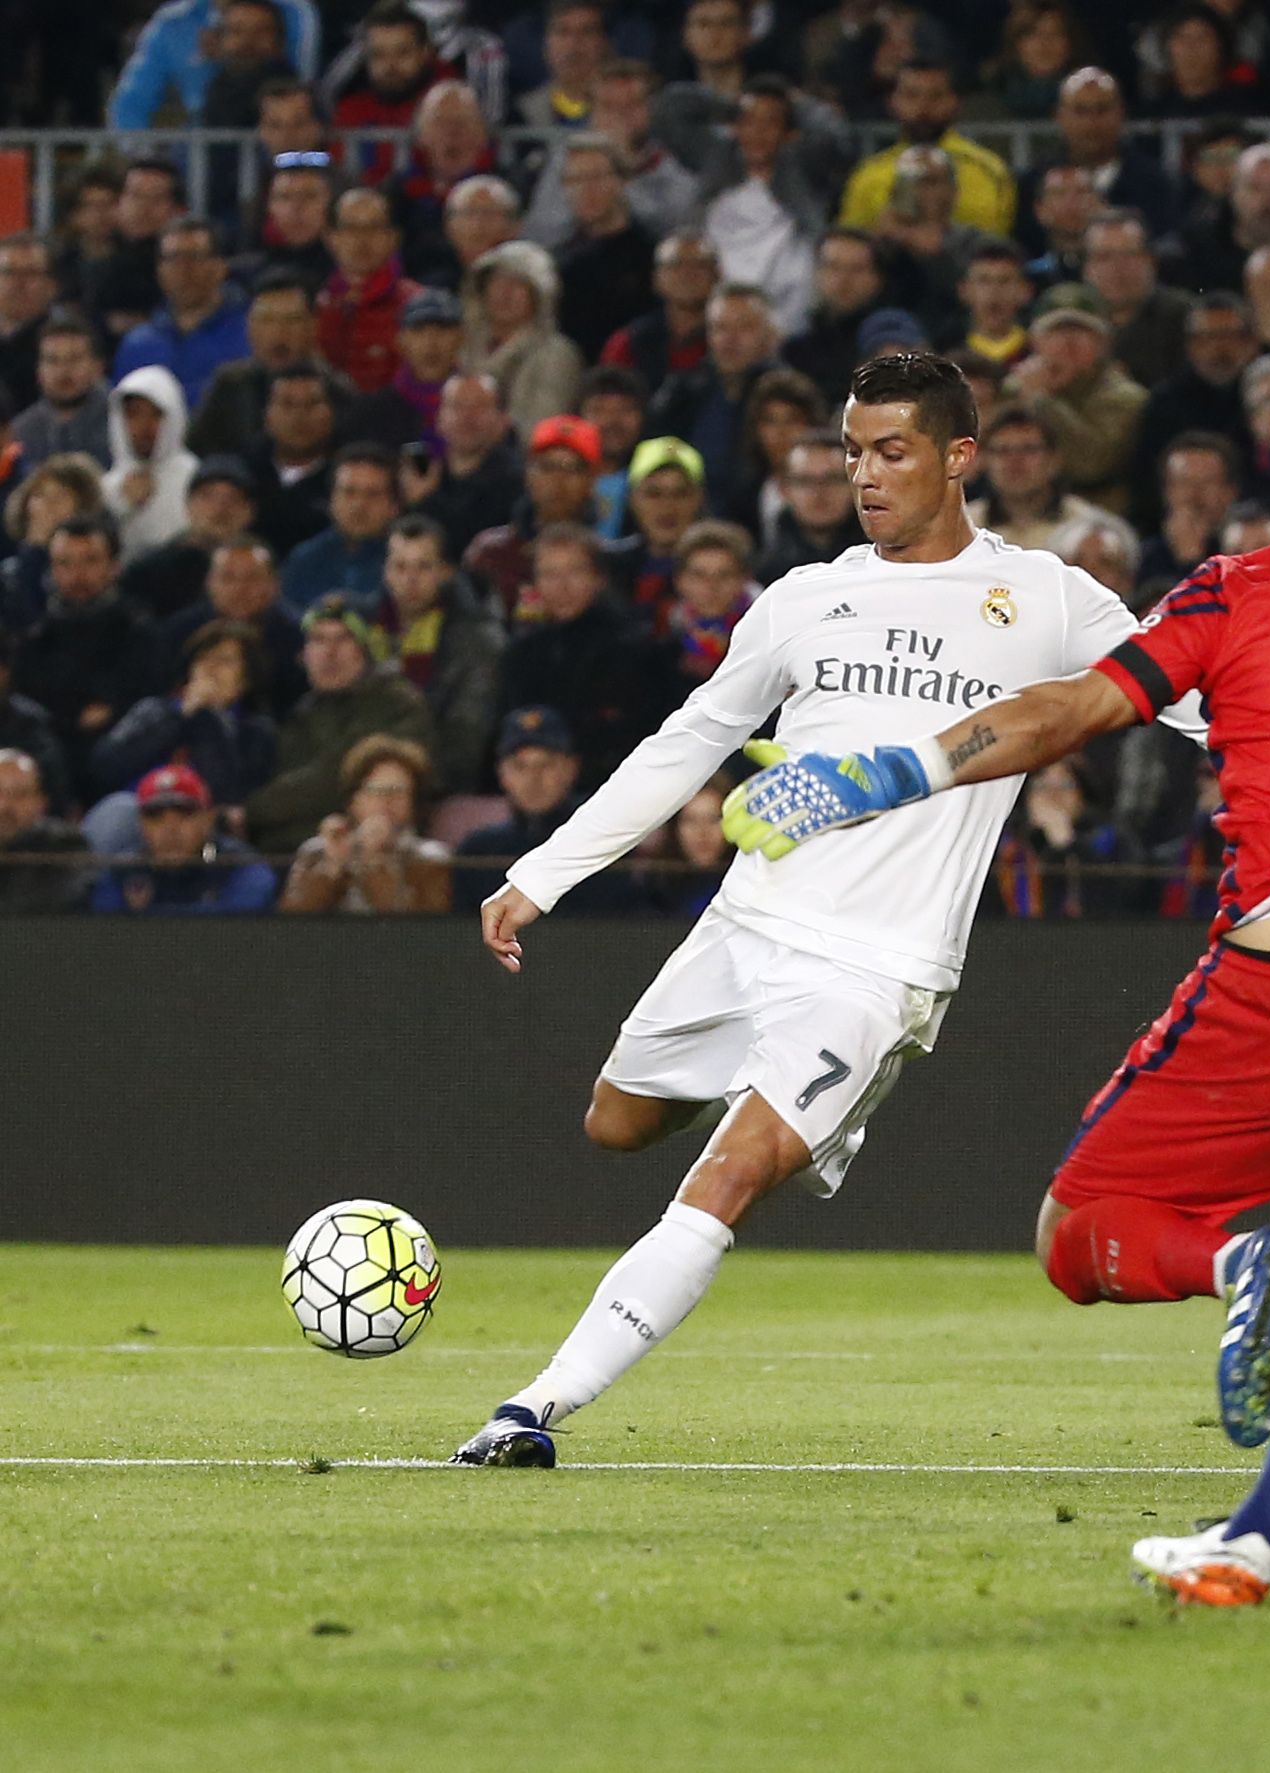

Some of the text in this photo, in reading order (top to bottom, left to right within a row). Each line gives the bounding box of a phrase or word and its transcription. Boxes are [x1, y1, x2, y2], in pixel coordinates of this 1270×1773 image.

[885, 628, 943, 661] Fly
[815, 656, 1003, 709] Emirates
[795, 1048, 851, 1112] 7
